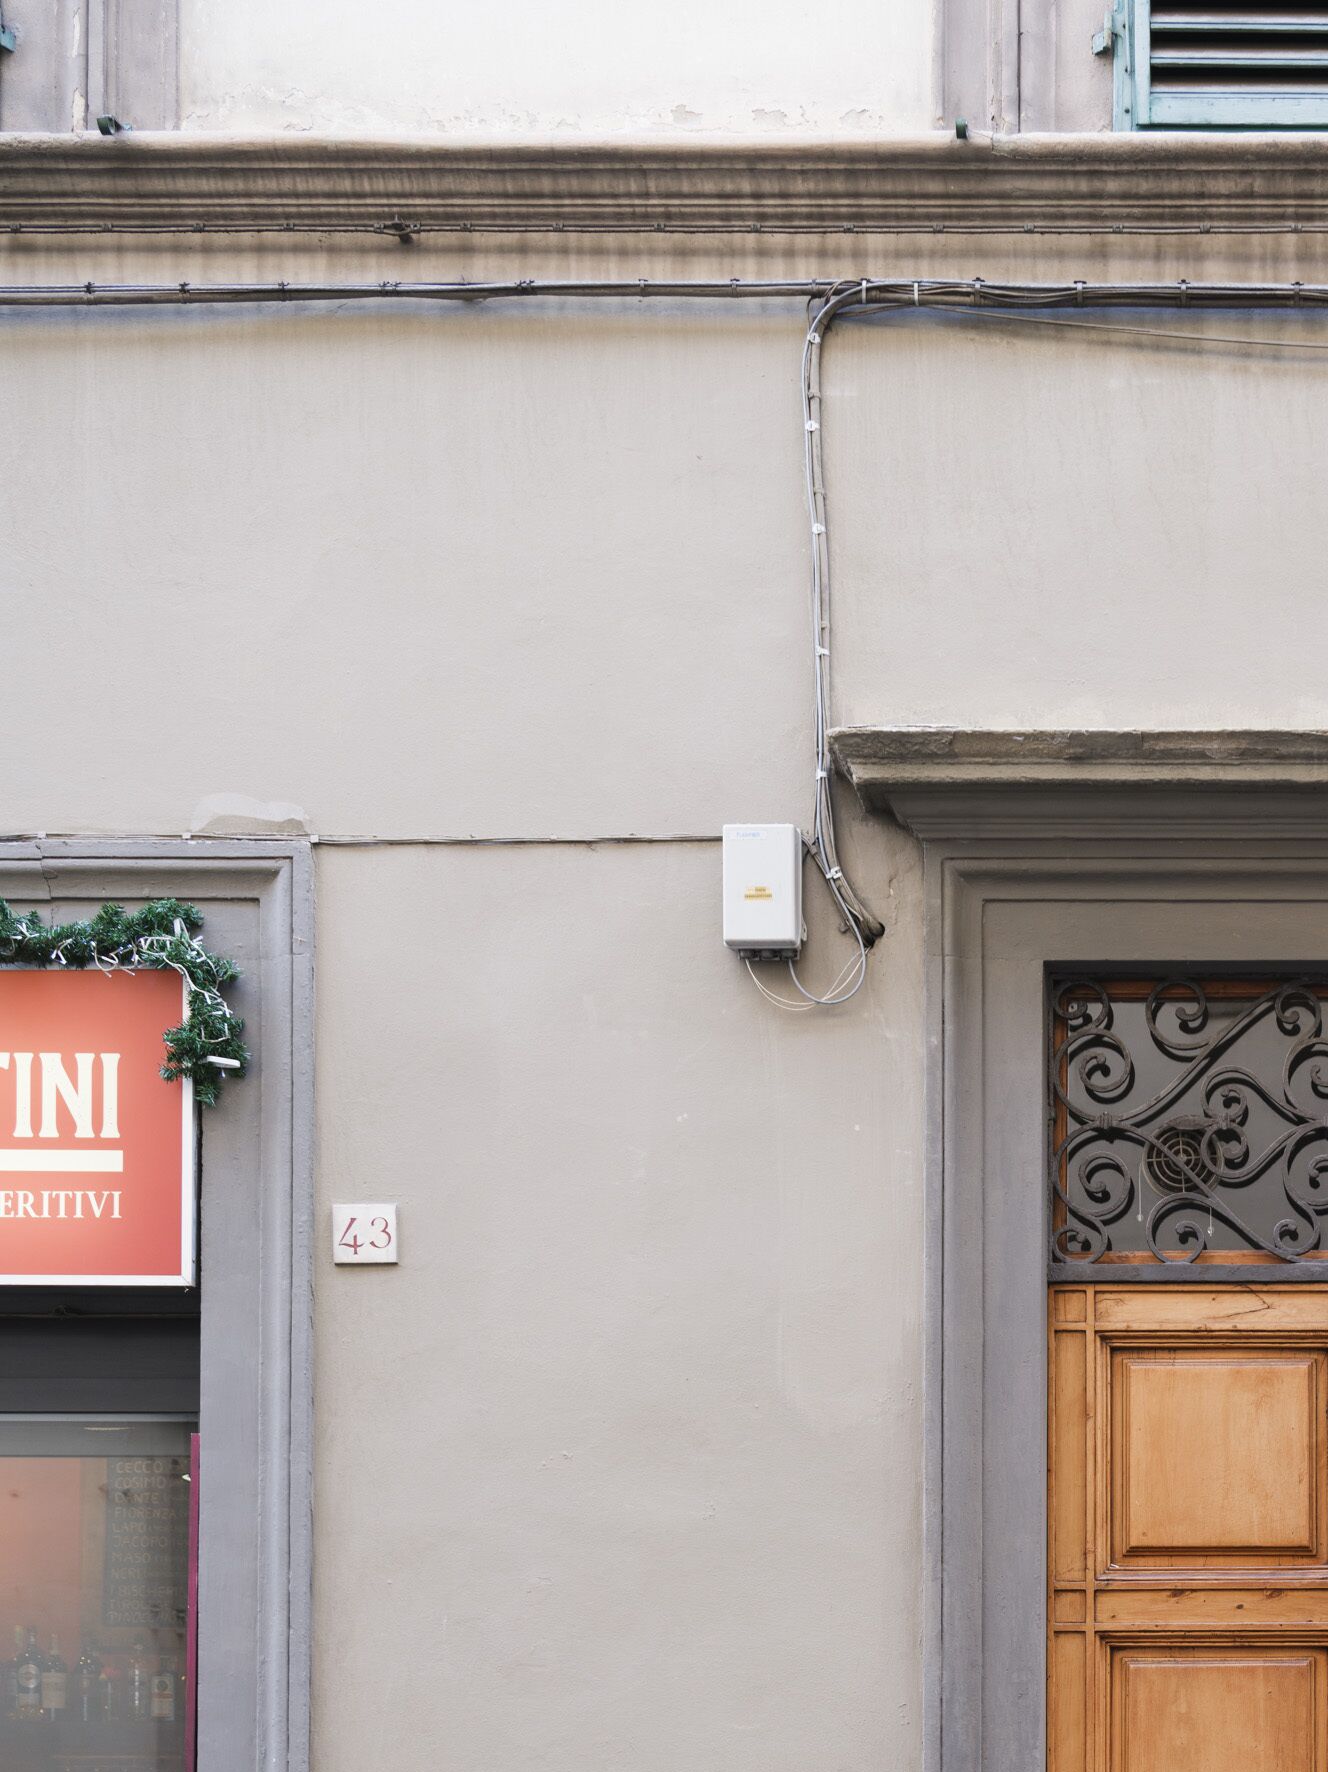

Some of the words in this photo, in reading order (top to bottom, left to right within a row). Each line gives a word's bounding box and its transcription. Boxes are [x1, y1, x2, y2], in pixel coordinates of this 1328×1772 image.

[0, 1190, 122, 1219] ERITIVI
[338, 1216, 392, 1255] 43
[116, 1461, 163, 1474] CECCO
[114, 1476, 166, 1489] COSIMO
